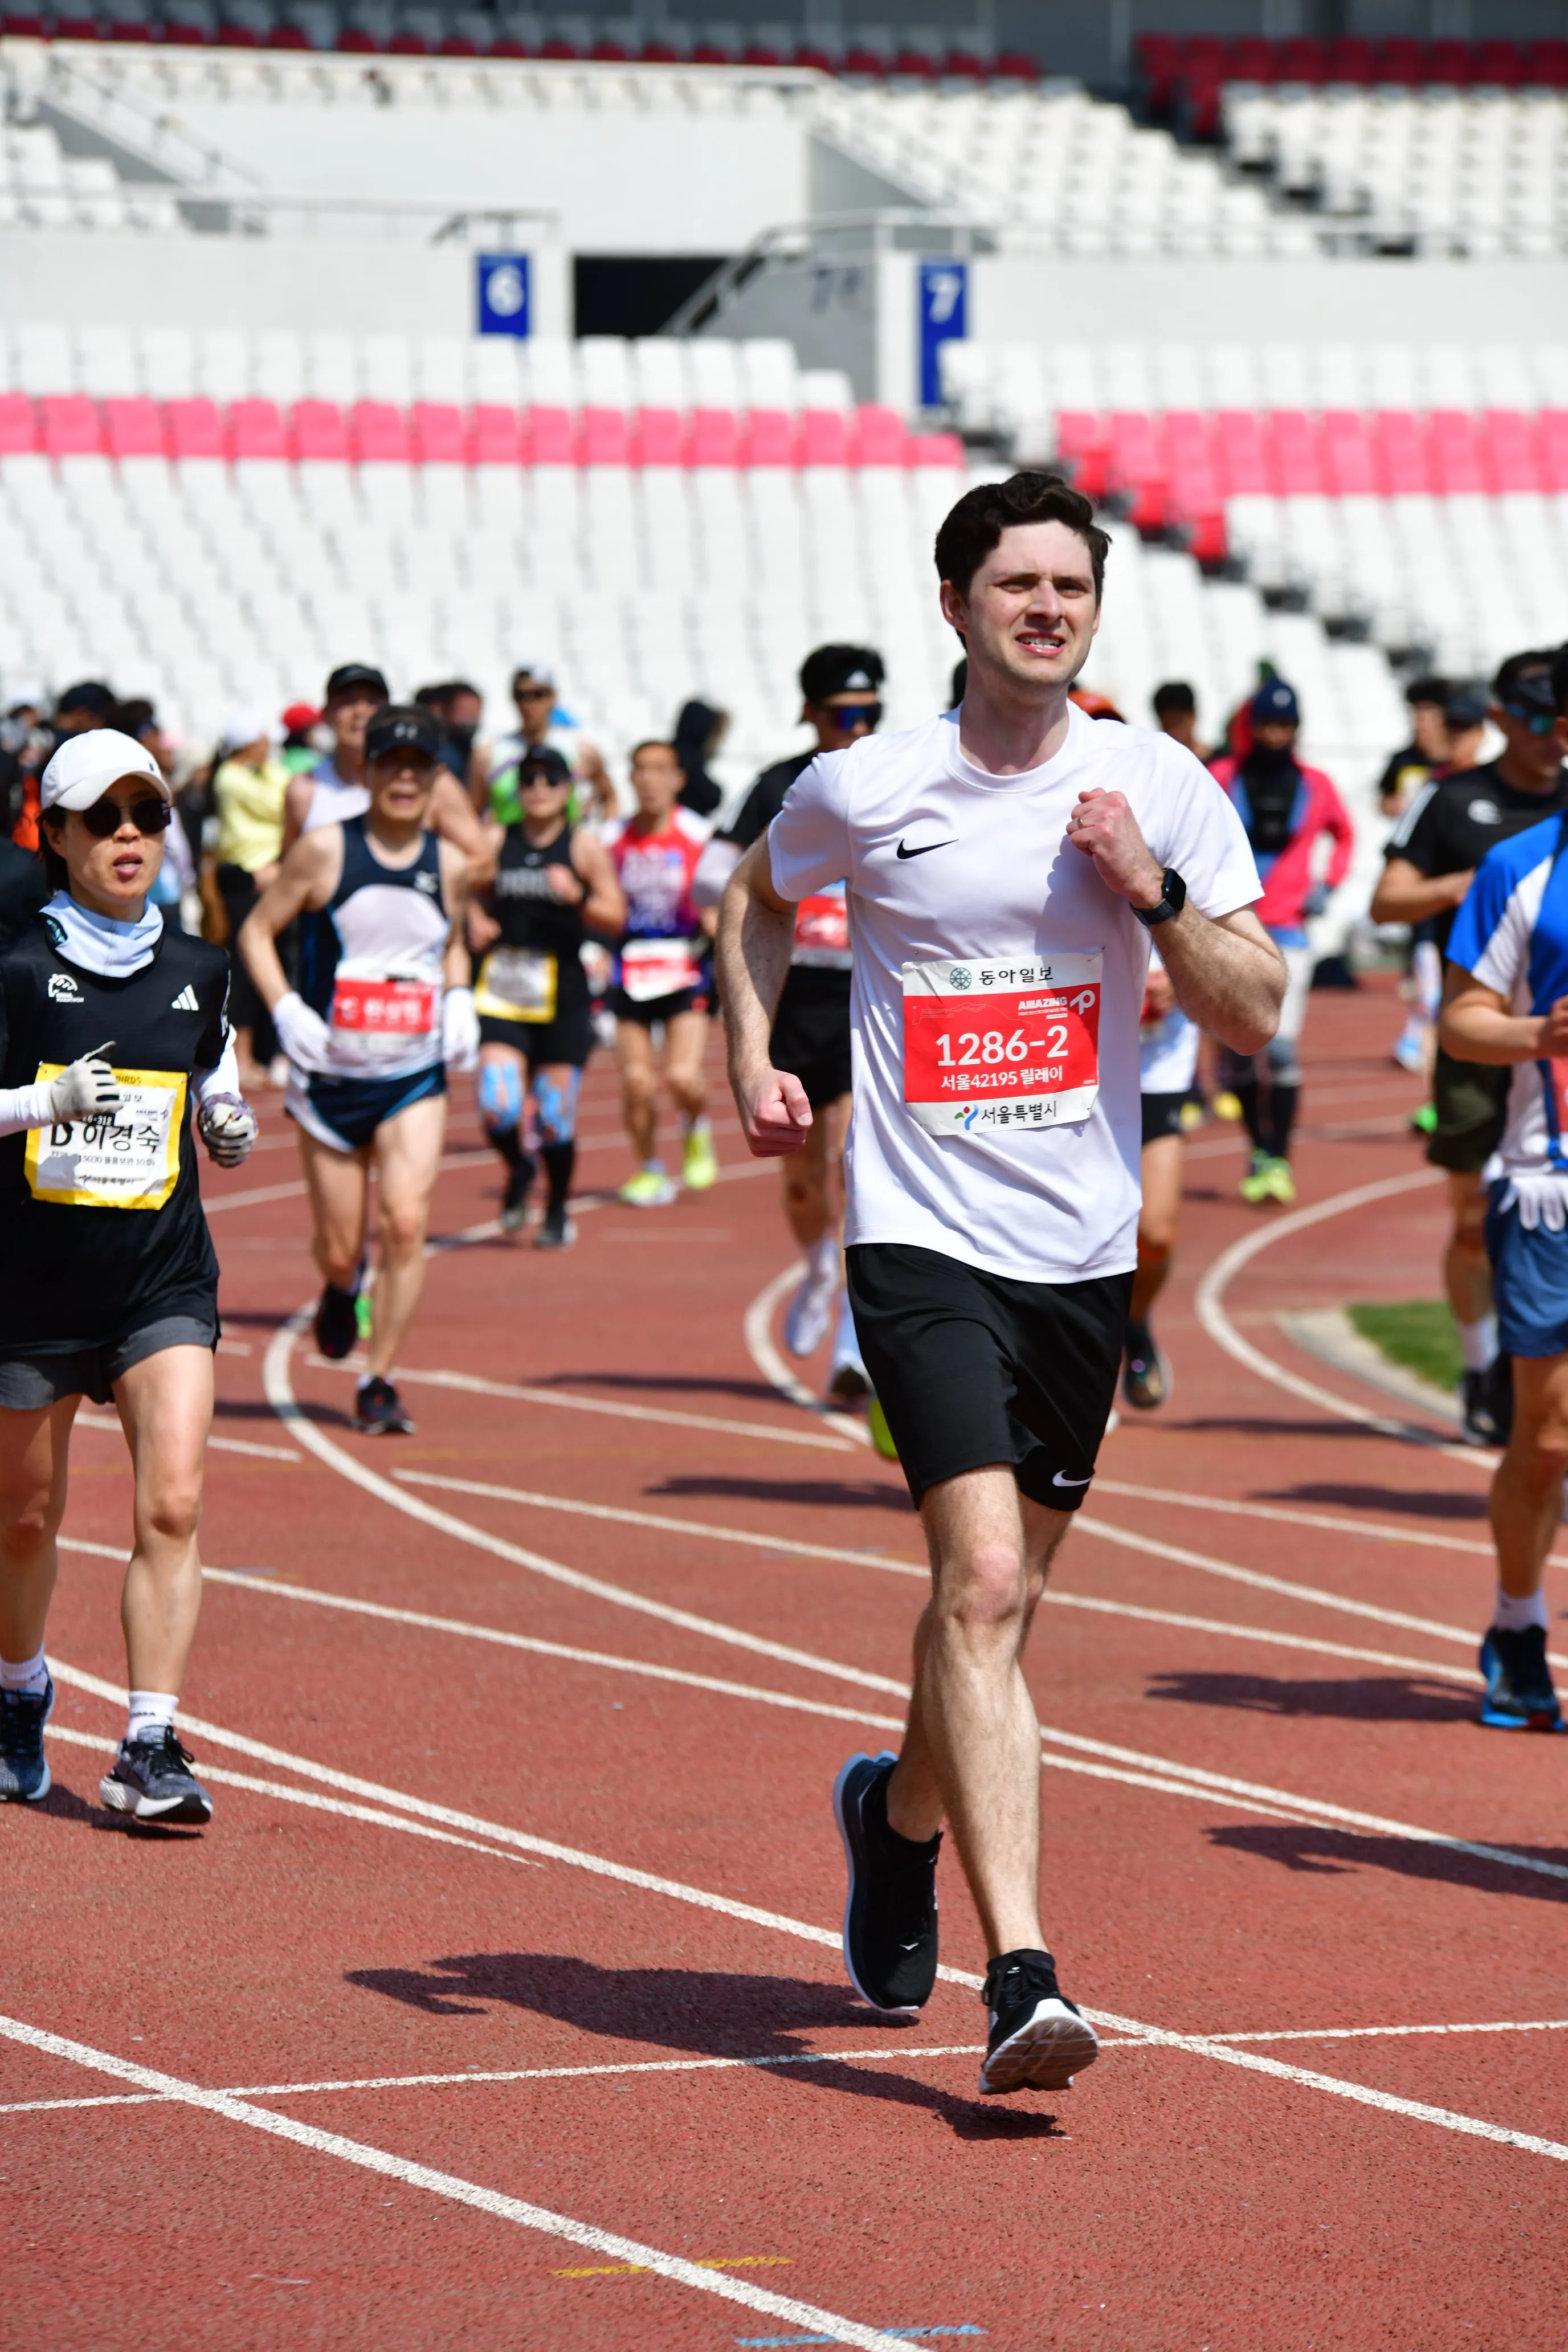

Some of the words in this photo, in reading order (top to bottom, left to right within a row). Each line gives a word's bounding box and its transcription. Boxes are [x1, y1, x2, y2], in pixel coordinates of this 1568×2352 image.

[487, 263, 525, 317] 6
[926, 272, 963, 323] 7
[979, 966, 1054, 986] 동아일보
[1018, 997, 1068, 1010] AMAZING
[935, 1025, 1069, 1067] 1286-2
[941, 1070, 1018, 1092] 서울42195
[1020, 1065, 1064, 1086] 릴레이
[981, 1100, 1057, 1125] 서울특별시
[83, 1124, 160, 1153] 이경숙
